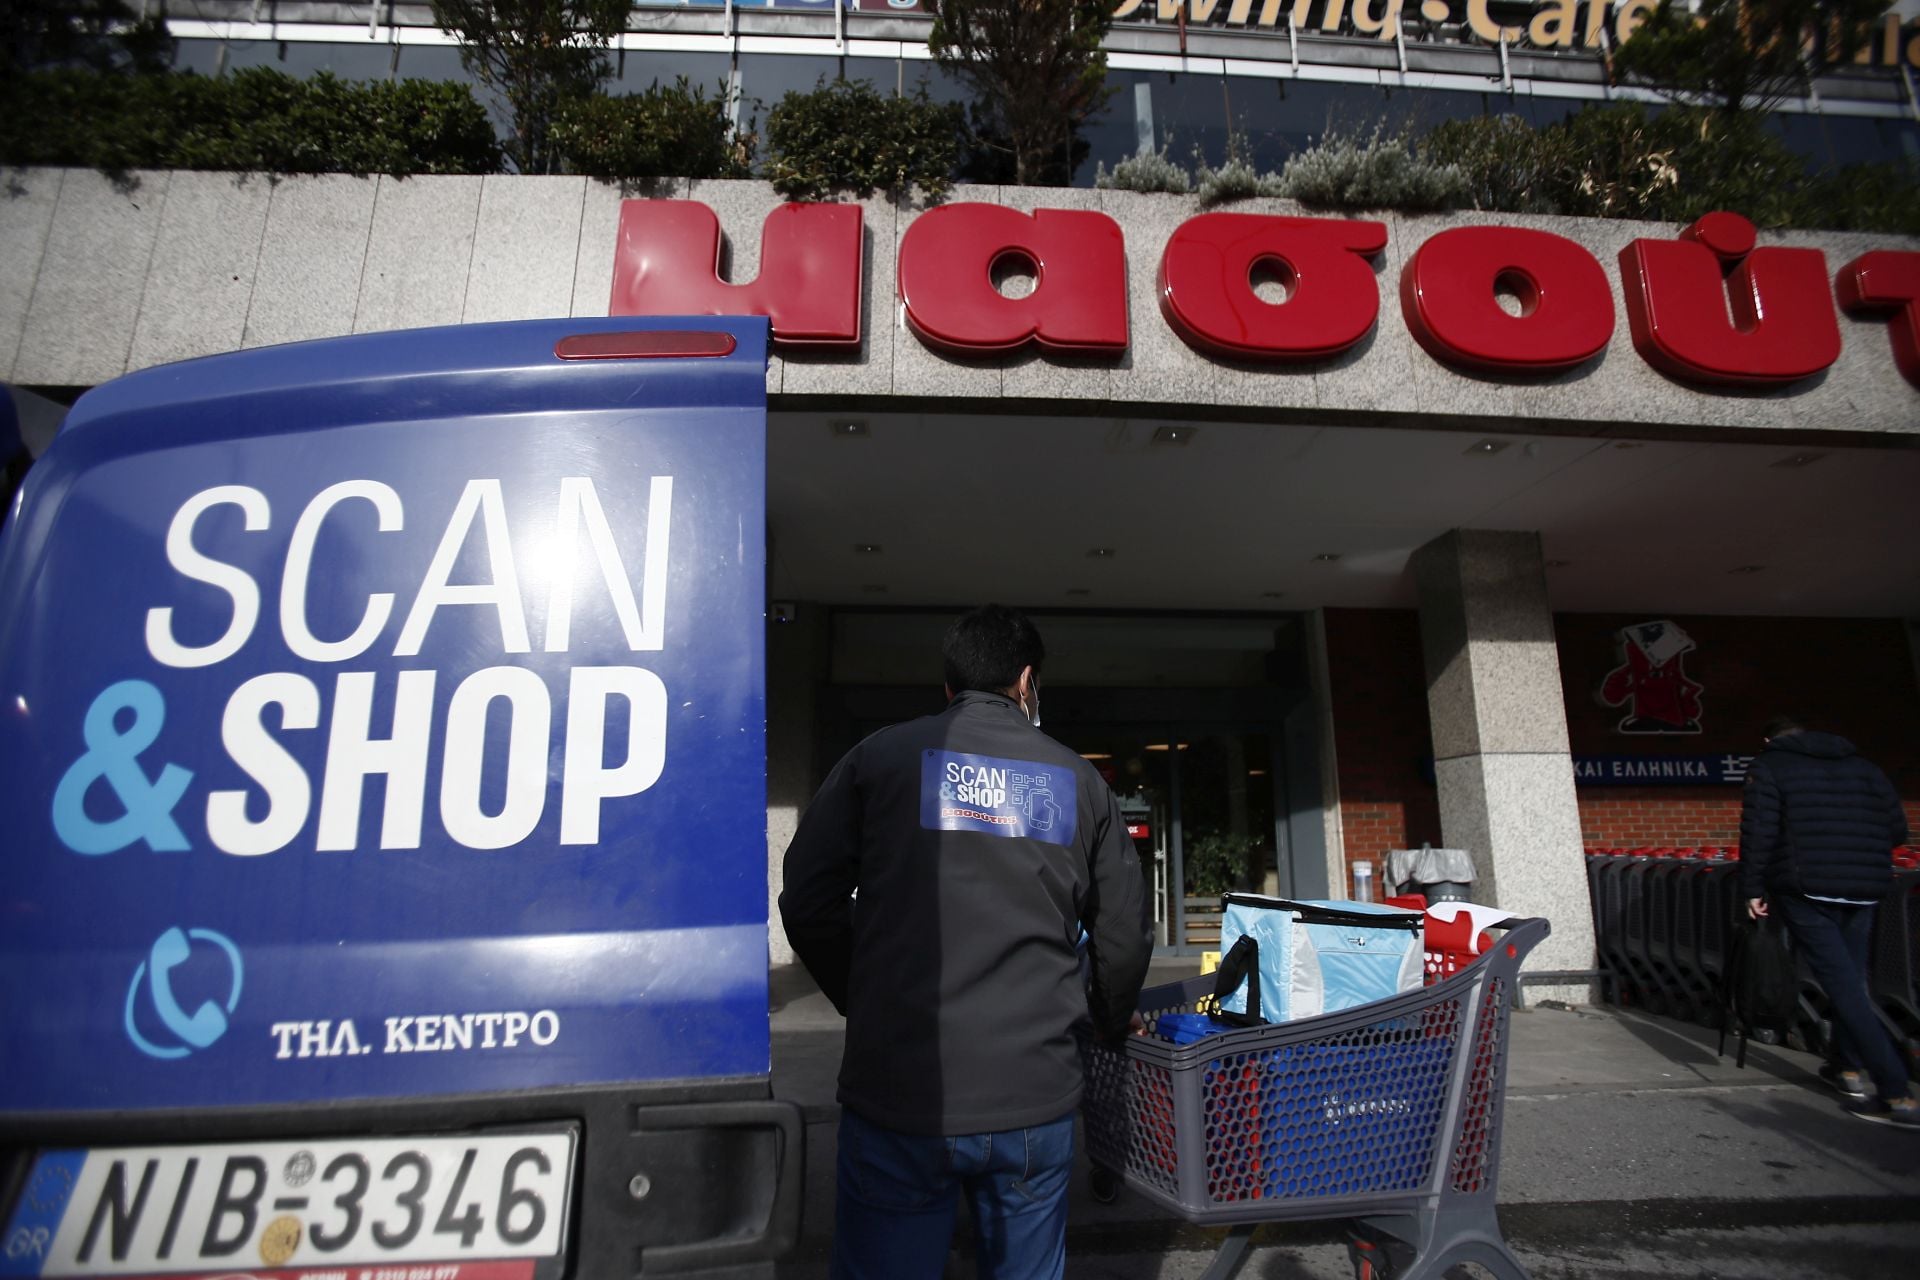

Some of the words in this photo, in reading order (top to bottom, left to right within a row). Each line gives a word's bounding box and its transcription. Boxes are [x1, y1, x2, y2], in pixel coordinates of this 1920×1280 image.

[145, 475, 674, 668] SCAN
[946, 762, 1006, 788] SCAN
[1613, 760, 1709, 778] ΕΛΛΗΝΙΚΑ
[272, 1019, 372, 1060] ΤΗΛ.
[384, 1009, 561, 1054] ΚΕΝΤΡΟ
